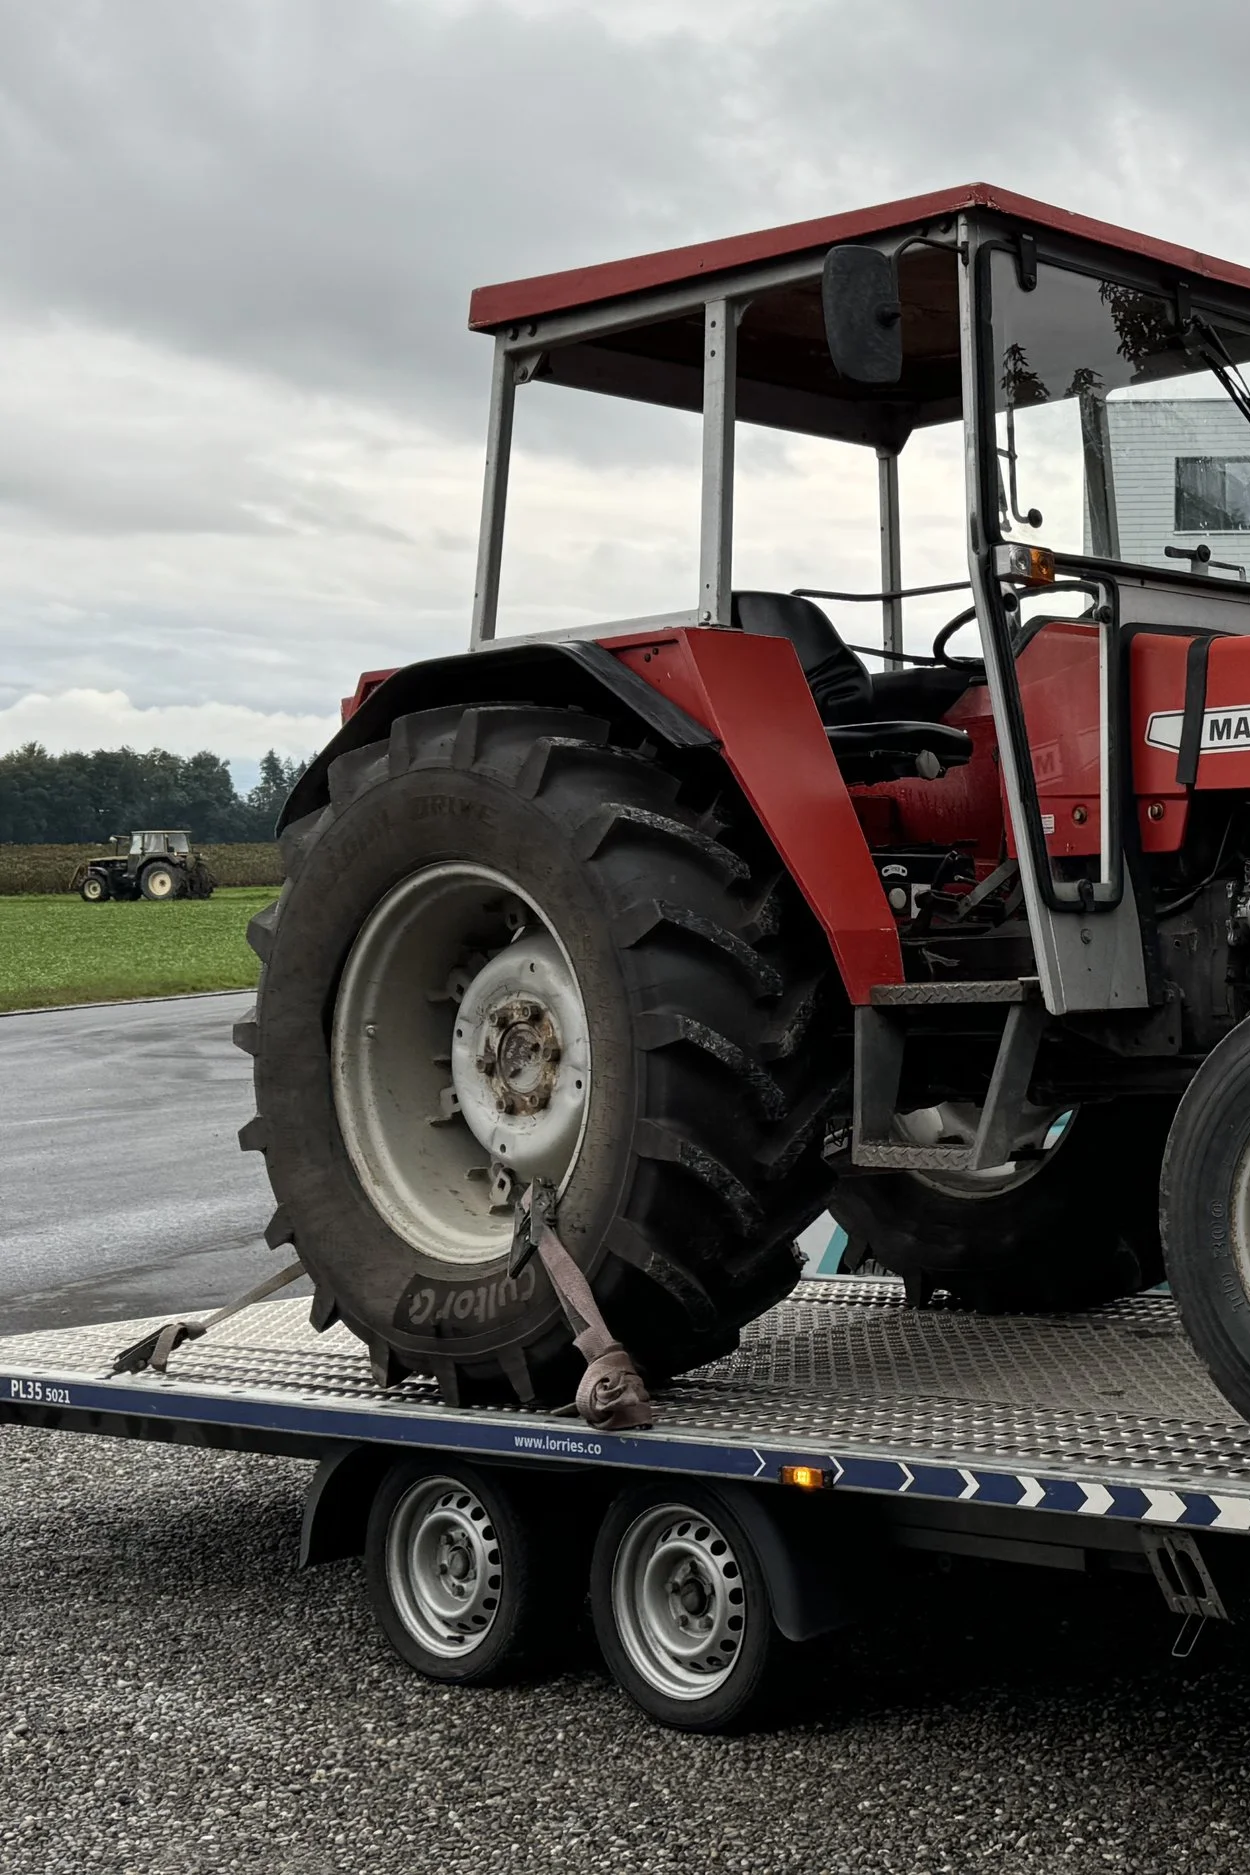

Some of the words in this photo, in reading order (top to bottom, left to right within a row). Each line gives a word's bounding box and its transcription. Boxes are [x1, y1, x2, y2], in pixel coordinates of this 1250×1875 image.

[10, 1379, 43, 1401] PL35
[45, 1388, 71, 1404] 5021
[514, 1435, 602, 1455] www.lorries.co
